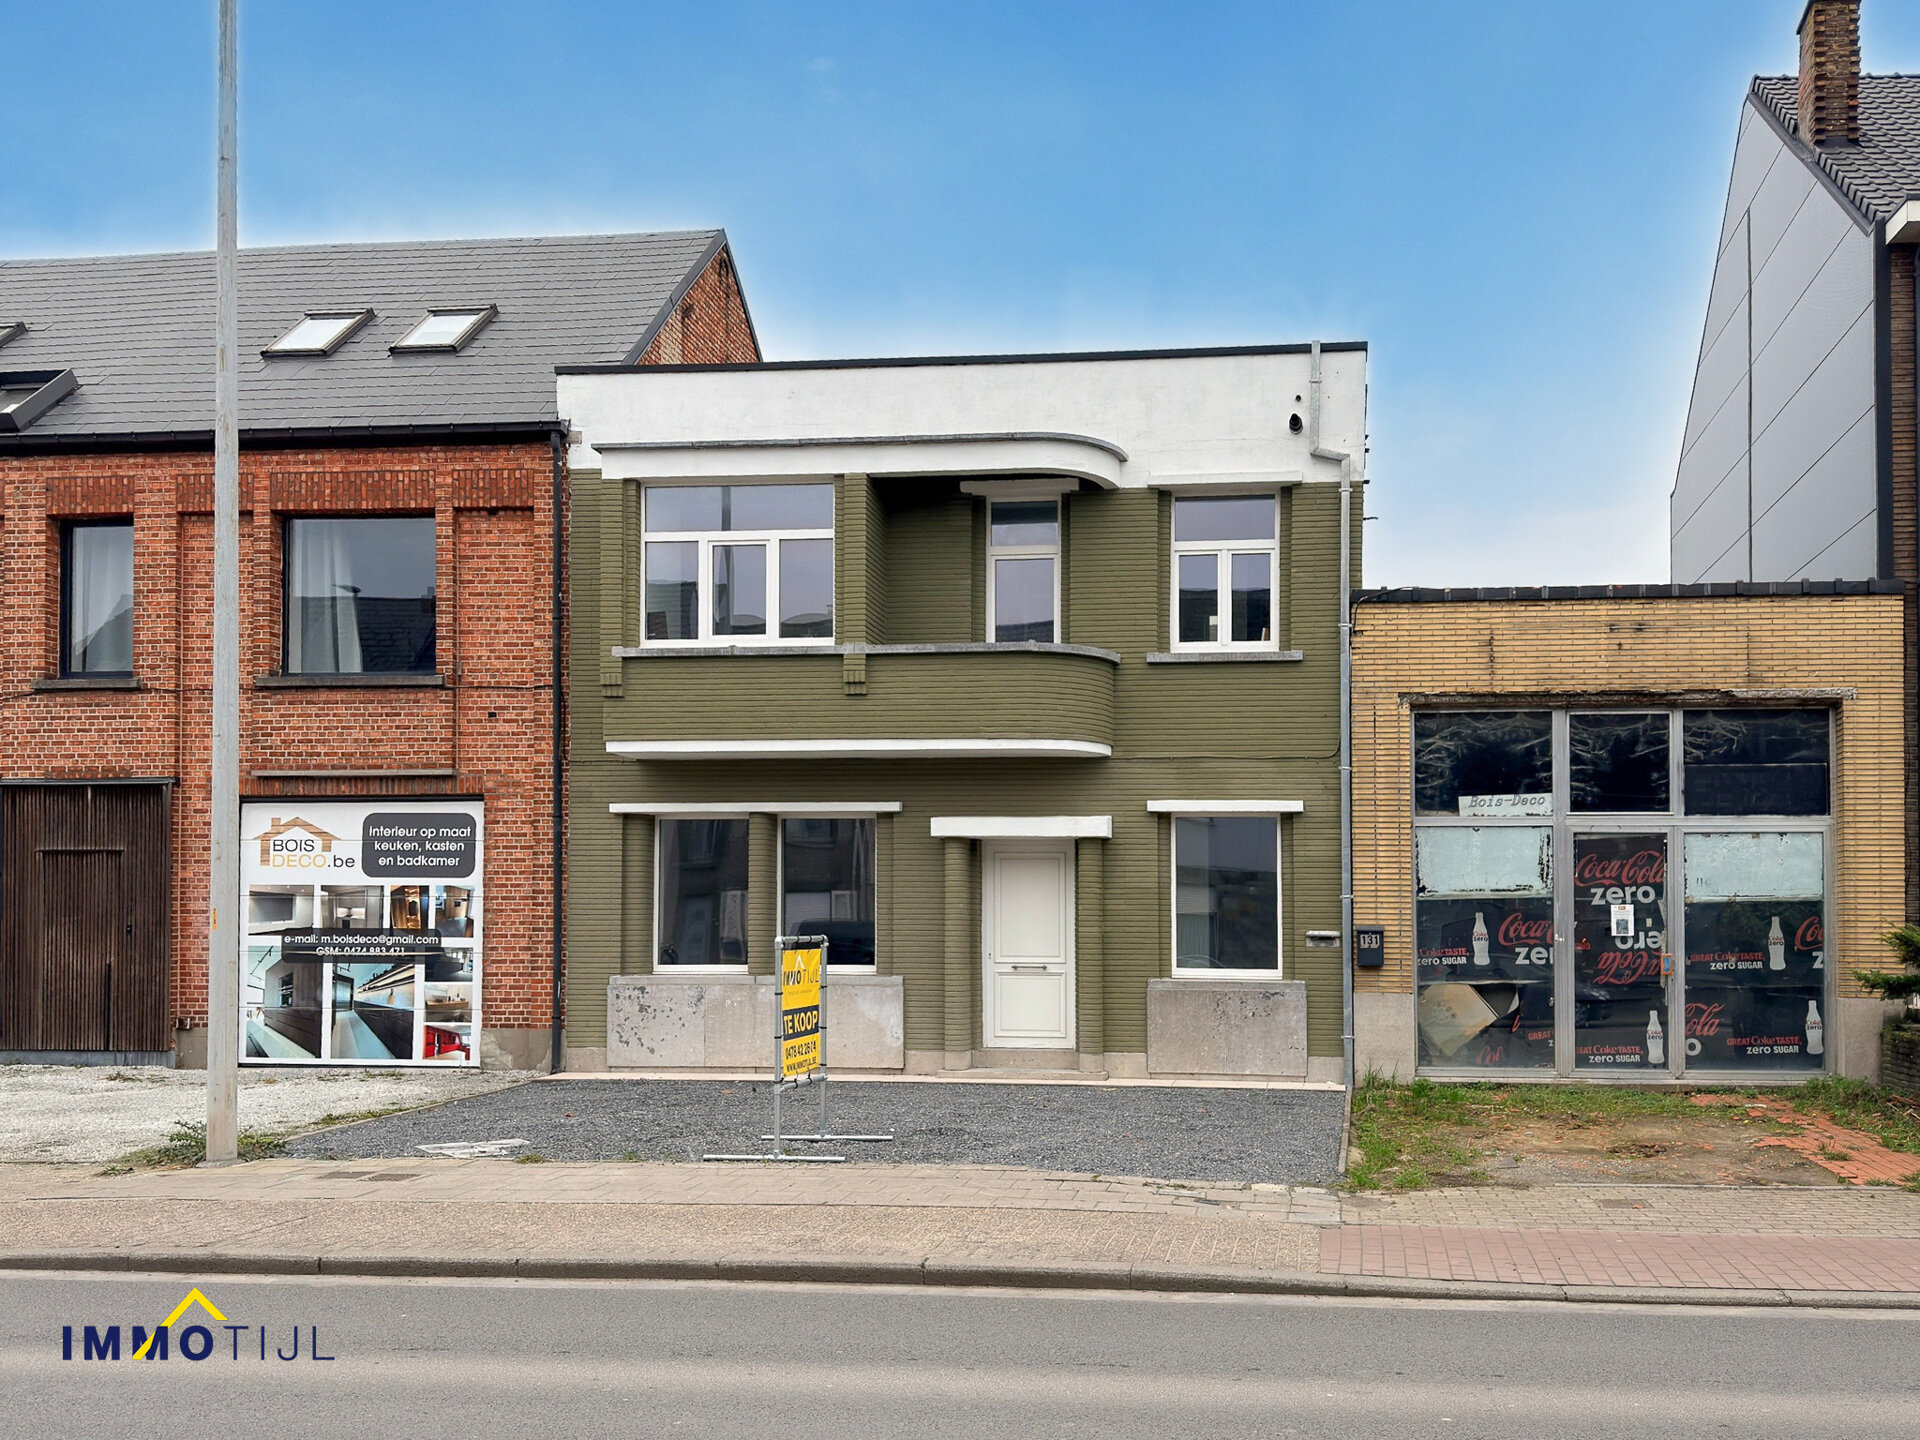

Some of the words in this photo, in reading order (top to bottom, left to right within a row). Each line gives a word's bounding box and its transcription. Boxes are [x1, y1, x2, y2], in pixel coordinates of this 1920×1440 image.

[1469, 795, 1546, 808] Bois-Deco
[369, 826, 417, 837] Interieur
[420, 828, 436, 839] op
[439, 826, 471, 837] maat
[273, 839, 315, 852] BOIS
[375, 841, 421, 852] keuken,
[425, 841, 464, 851] kasten
[272, 854, 355, 868] DECO.be
[378, 857, 393, 866] en
[397, 855, 460, 866] badkamer
[1590, 885, 1655, 905] zero
[284, 935, 318, 944] e-mail:
[321, 935, 439, 946] m.boisdeco@gmail.com
[1361, 936, 1379, 946] 131
[1444, 947, 1469, 957] TASTE,
[1442, 956, 1467, 965] SUGAR
[1710, 962, 1735, 970] zero
[1737, 961, 1763, 969] SUGAR
[784, 1015, 793, 1035] TE
[794, 1011, 818, 1033] KOOP
[1751, 1036, 1774, 1045] Coke
[1775, 1036, 1802, 1045] TASTE,
[1593, 1045, 1617, 1054] Coke
[1618, 1046, 1643, 1055] TASTE,
[1747, 1046, 1771, 1054] zero
[1774, 1045, 1799, 1053] SUGAR
[1589, 1055, 1613, 1063] zero
